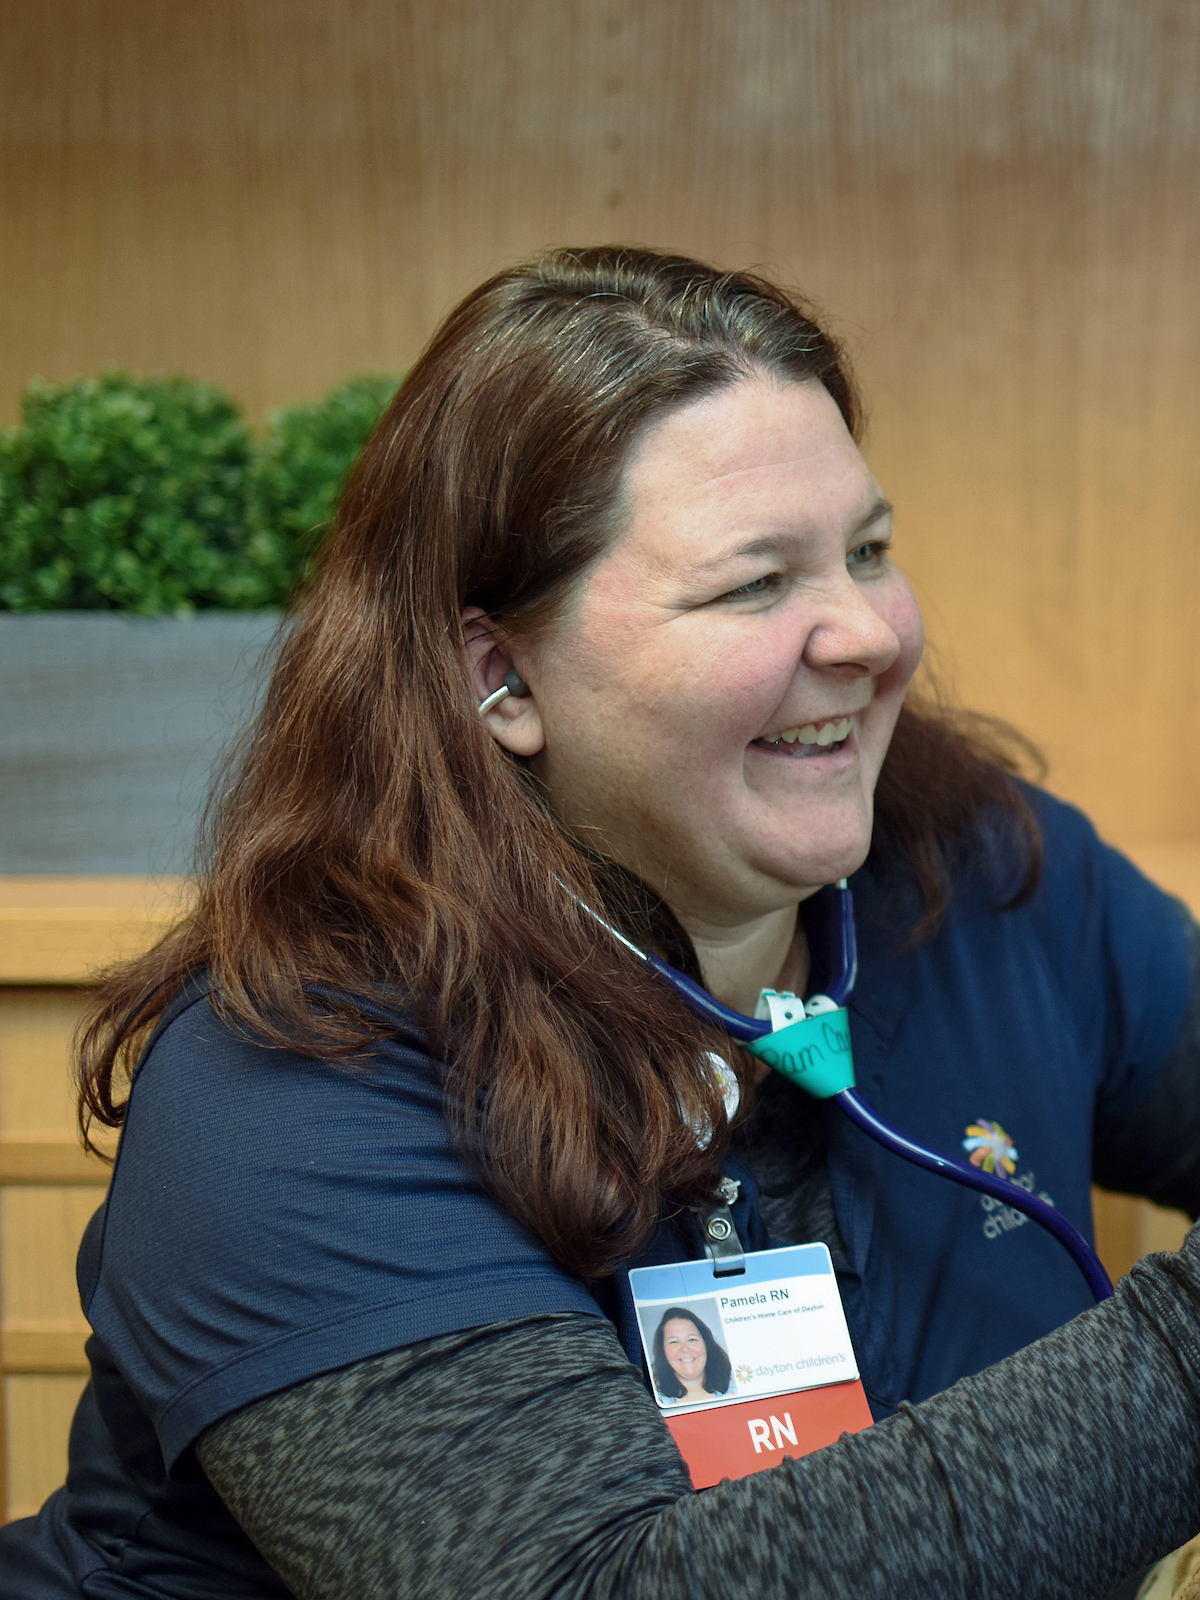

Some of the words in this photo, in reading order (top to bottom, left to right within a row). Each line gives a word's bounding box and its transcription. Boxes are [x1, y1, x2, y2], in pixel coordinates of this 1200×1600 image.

[761, 1044, 825, 1075] Pam
[720, 1292, 767, 1309] Pamela
[769, 1288, 789, 1301] RN
[724, 1314, 756, 1324] Children's
[777, 1309, 792, 1317] Care
[793, 1306, 800, 1314] of
[801, 1304, 825, 1312] Dayton
[755, 1362, 793, 1376] dayton
[795, 1352, 847, 1370] children's
[747, 1412, 799, 1454] RN
